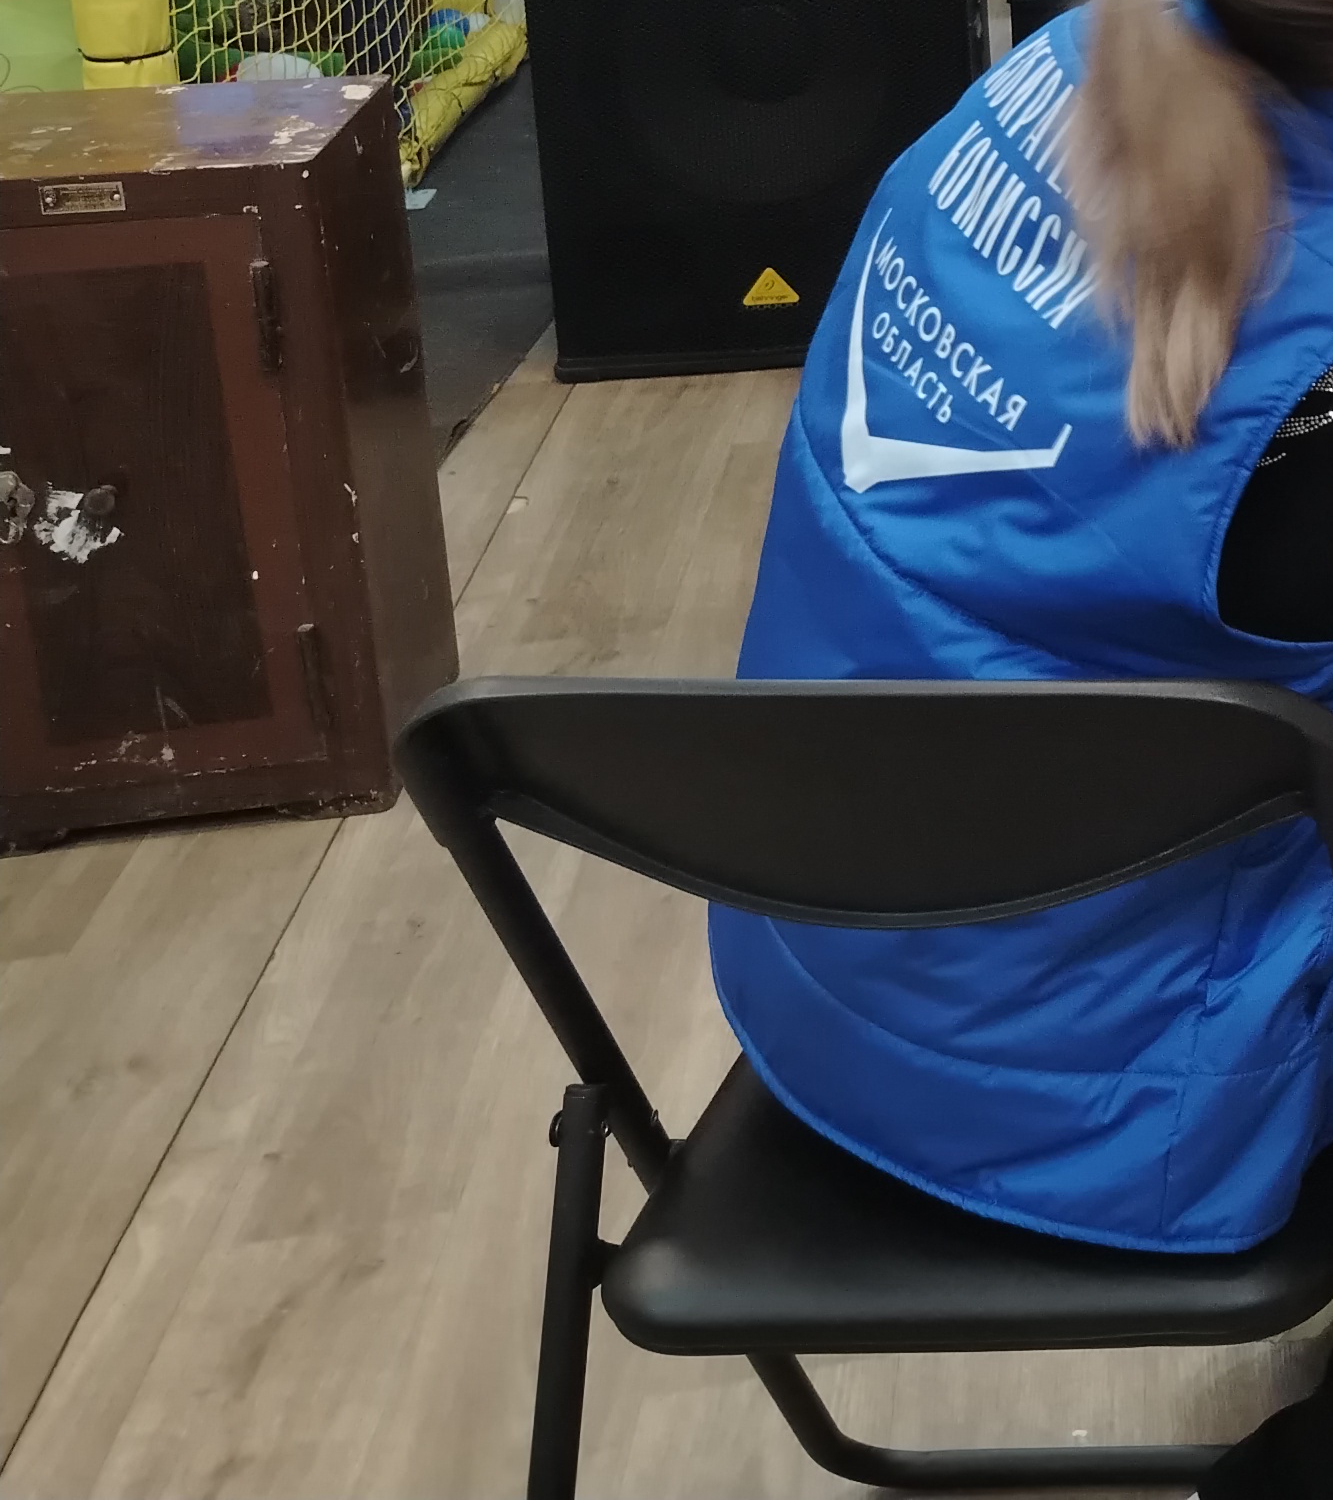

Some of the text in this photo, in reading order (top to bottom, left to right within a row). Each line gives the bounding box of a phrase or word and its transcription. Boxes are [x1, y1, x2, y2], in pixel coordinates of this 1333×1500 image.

[927, 119, 1100, 330] КОМИССИЯ
[872, 311, 954, 424] ОБЛАСТЬ
[874, 236, 1028, 431] МОСКОВСКАЯ
